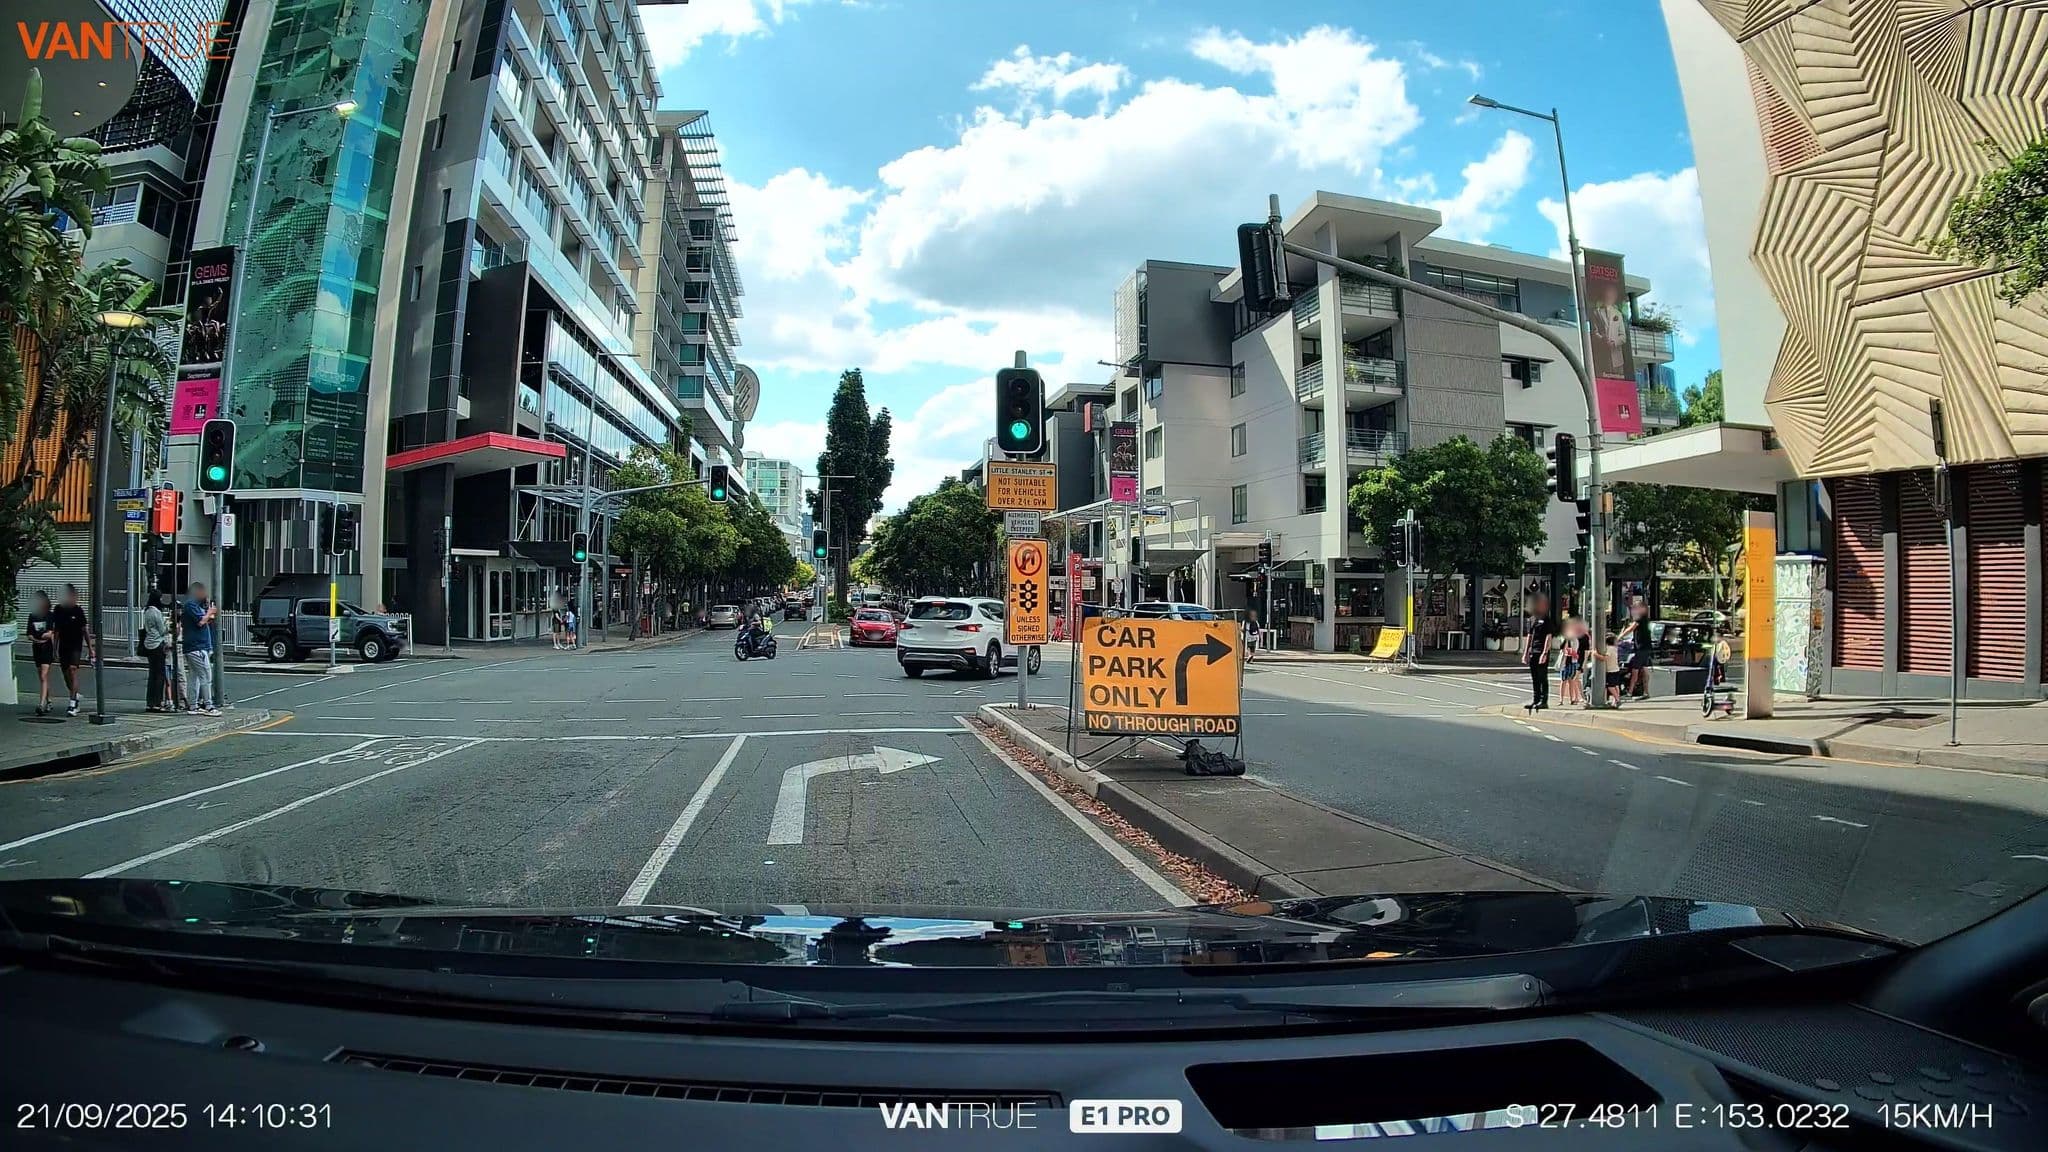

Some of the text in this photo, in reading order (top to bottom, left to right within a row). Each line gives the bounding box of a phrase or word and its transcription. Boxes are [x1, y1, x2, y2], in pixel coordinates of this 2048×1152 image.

[194, 263, 228, 279] GEMS
[1590, 264, 1618, 278] GATSBY
[998, 477, 1047, 487] NOT SUITABLE
[998, 487, 1047, 497] FOR VEHICLES
[998, 497, 1015, 505] OVER
[1034, 498, 1047, 506] GVM
[1073, 574, 1081, 601] STREET
[1016, 615, 1041, 623] UNLESS
[1017, 625, 1040, 633] SIGNED
[1011, 633, 1046, 641] OTHERWISE
[1097, 625, 1156, 648] CAR
[1089, 655, 1167, 679] PARK
[1089, 684, 1168, 708] ONLY
[1088, 713, 1237, 733] NO THROUGH ROAD
